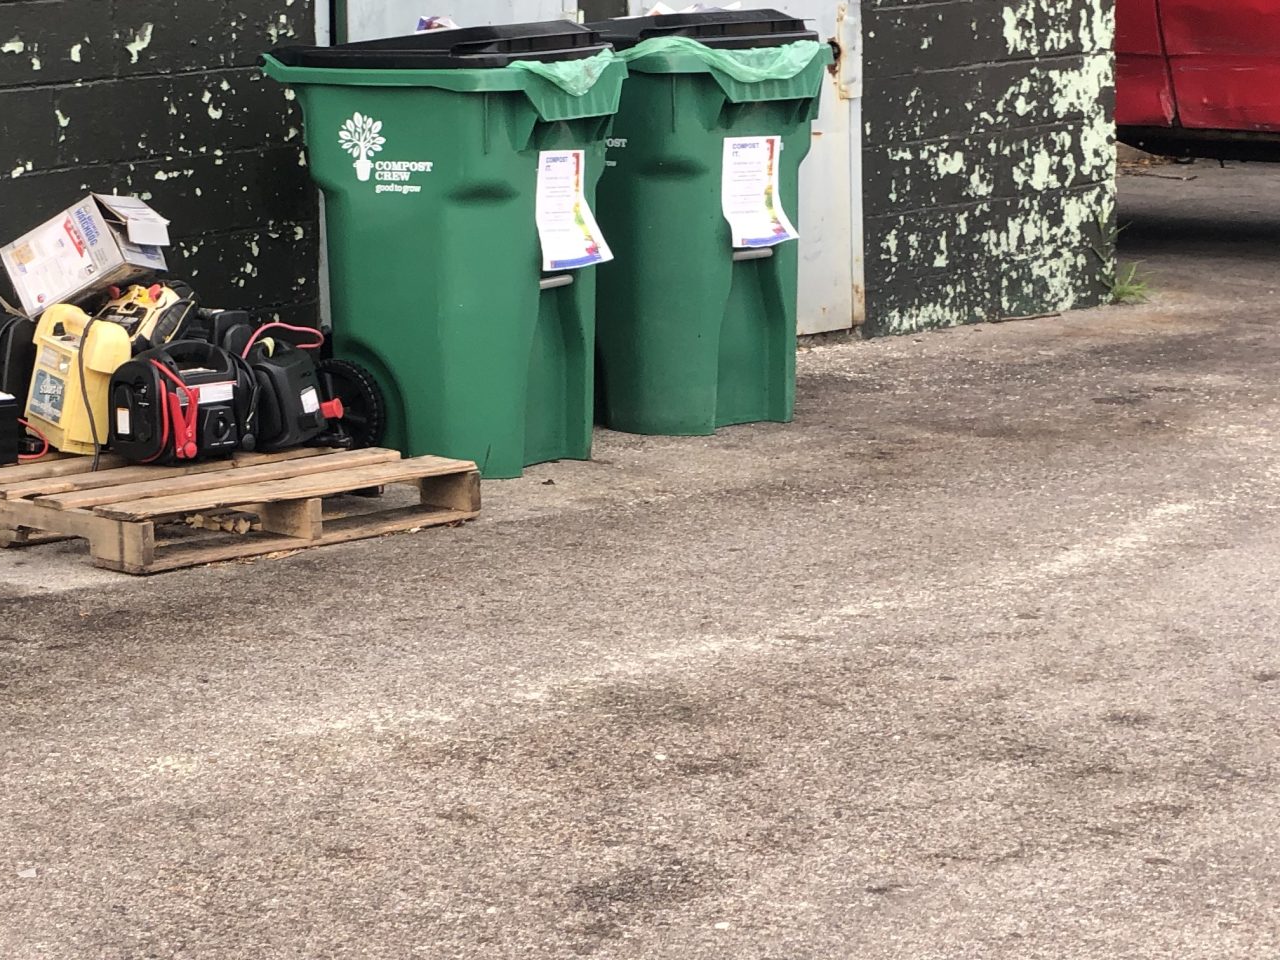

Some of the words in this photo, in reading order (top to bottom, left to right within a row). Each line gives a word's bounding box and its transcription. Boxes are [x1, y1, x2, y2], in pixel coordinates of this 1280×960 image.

[732, 142, 760, 150] COMPOST
[375, 161, 433, 172] COMPOST
[375, 171, 411, 181] CREW
[375, 183, 394, 193] good
[402, 185, 422, 194] grow
[74, 208, 98, 246] WATCHDOG
